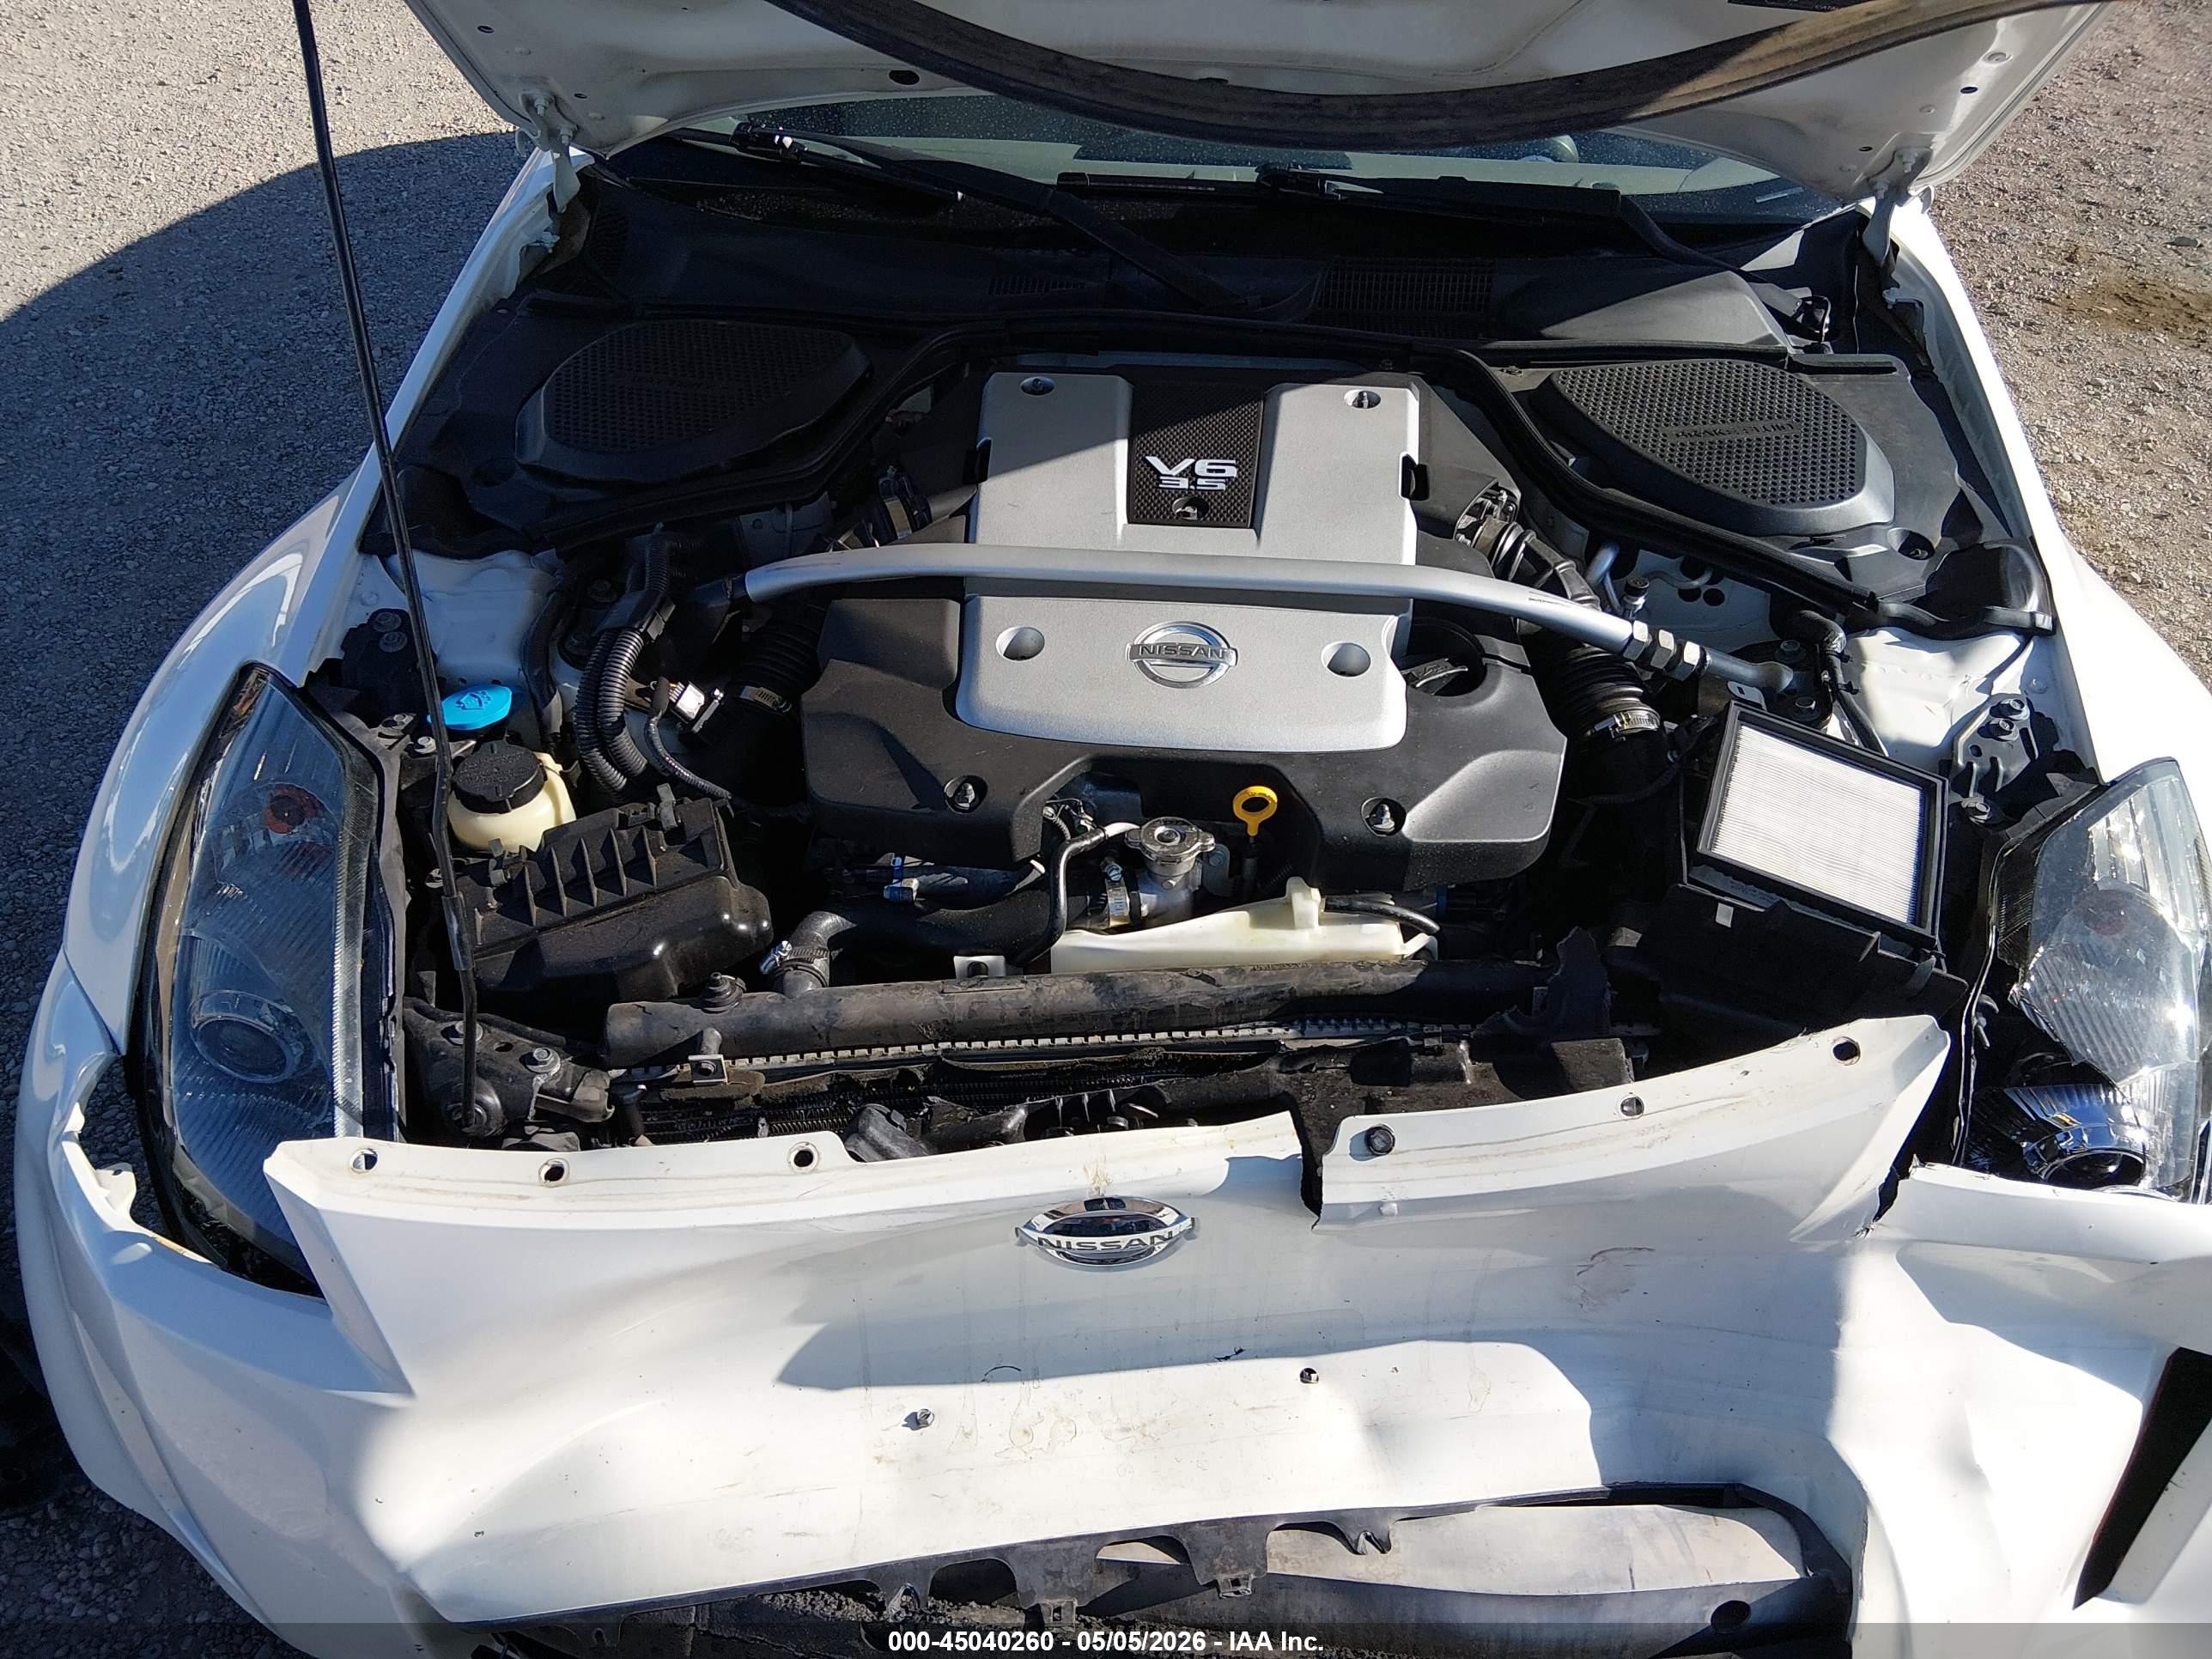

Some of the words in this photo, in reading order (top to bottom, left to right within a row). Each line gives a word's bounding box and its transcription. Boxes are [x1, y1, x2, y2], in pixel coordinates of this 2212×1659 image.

[1145, 455, 1237, 477] V6
[1158, 476, 1227, 491] 3.5
[1139, 644, 1224, 659] NISSAN
[1036, 1230, 1174, 1251] NISSAN
